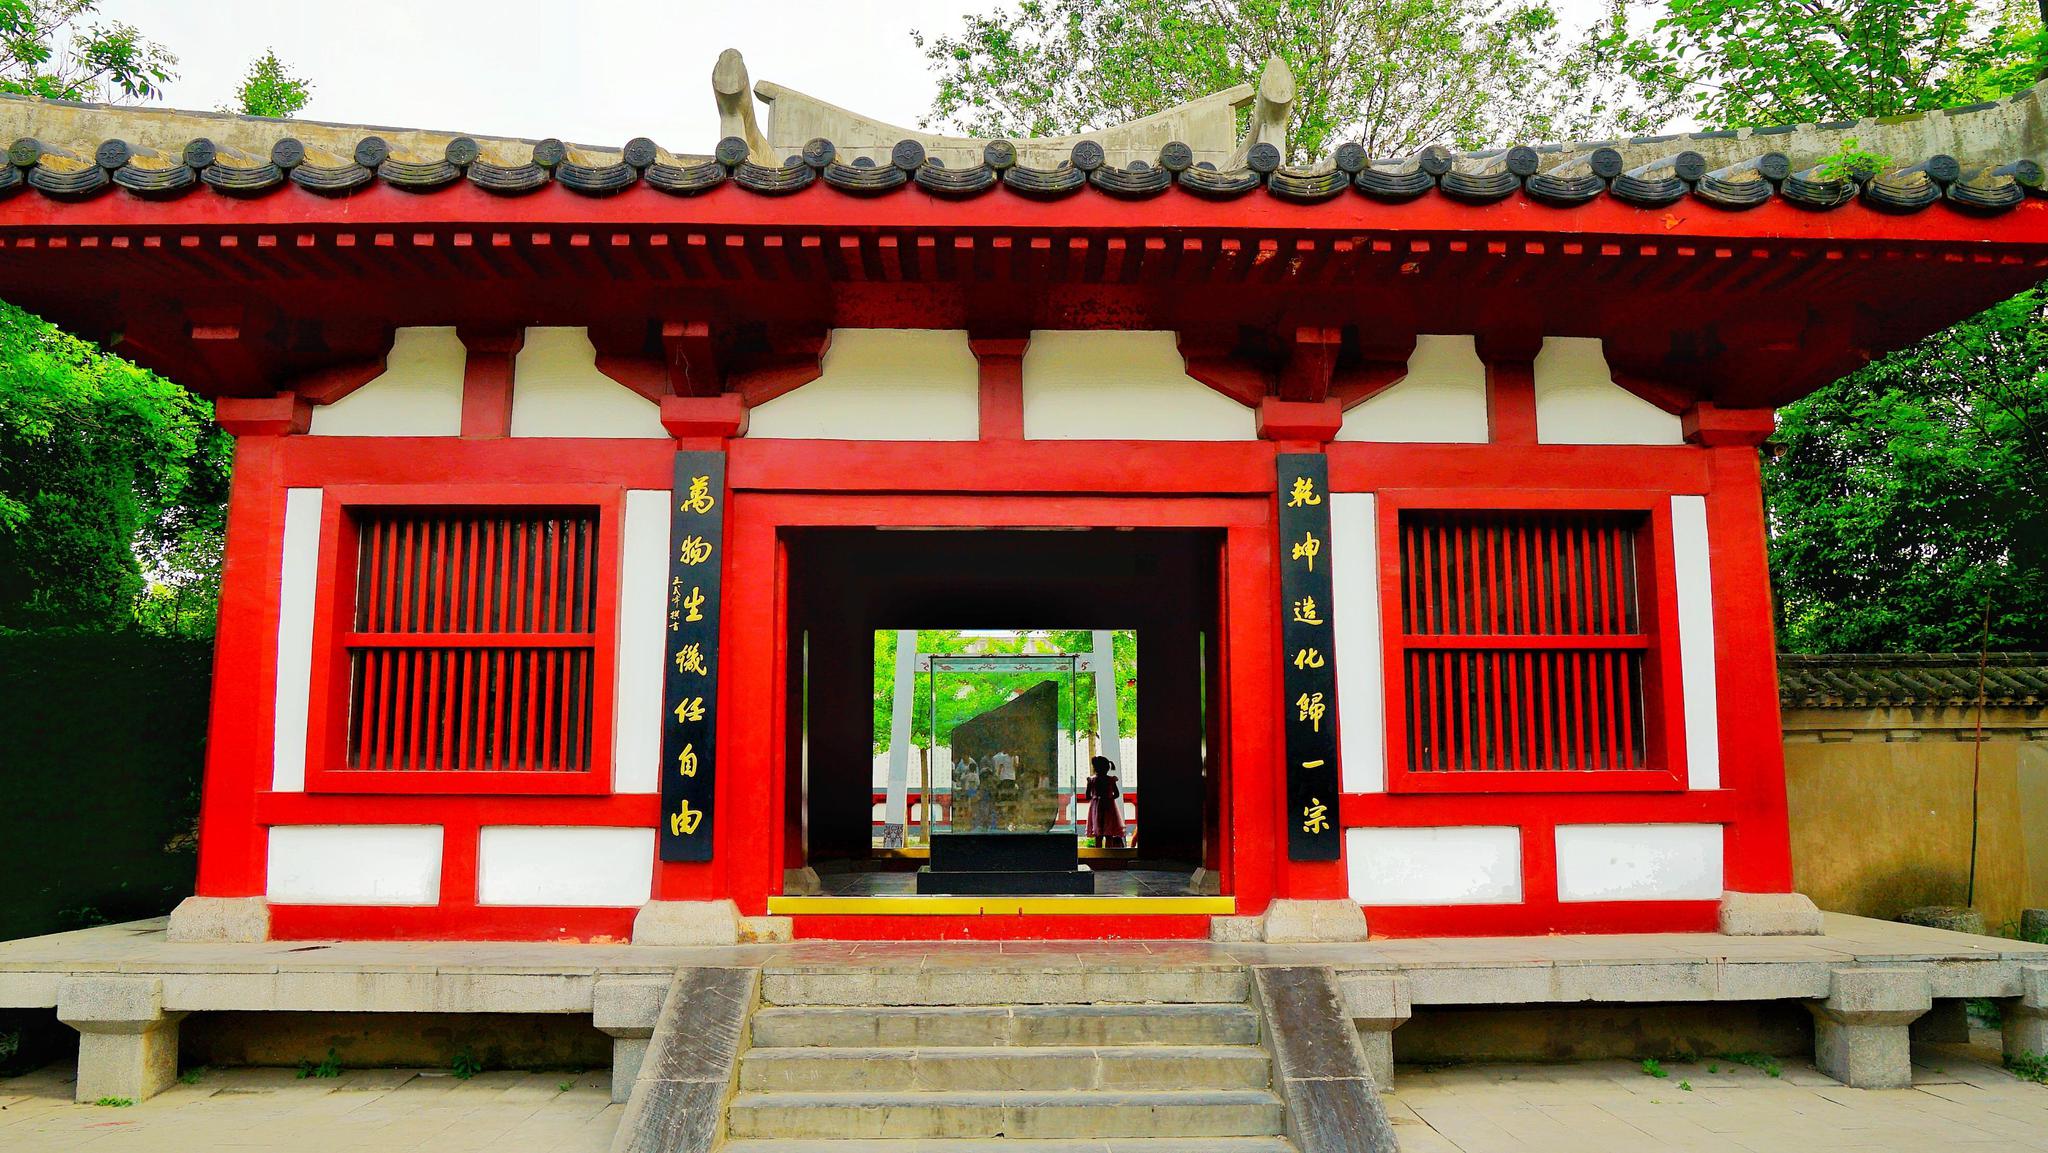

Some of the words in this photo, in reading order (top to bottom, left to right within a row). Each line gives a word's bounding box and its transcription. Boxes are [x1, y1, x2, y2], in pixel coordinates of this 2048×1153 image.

[1287, 476, 1329, 834] 乾坤造化歸一宗
